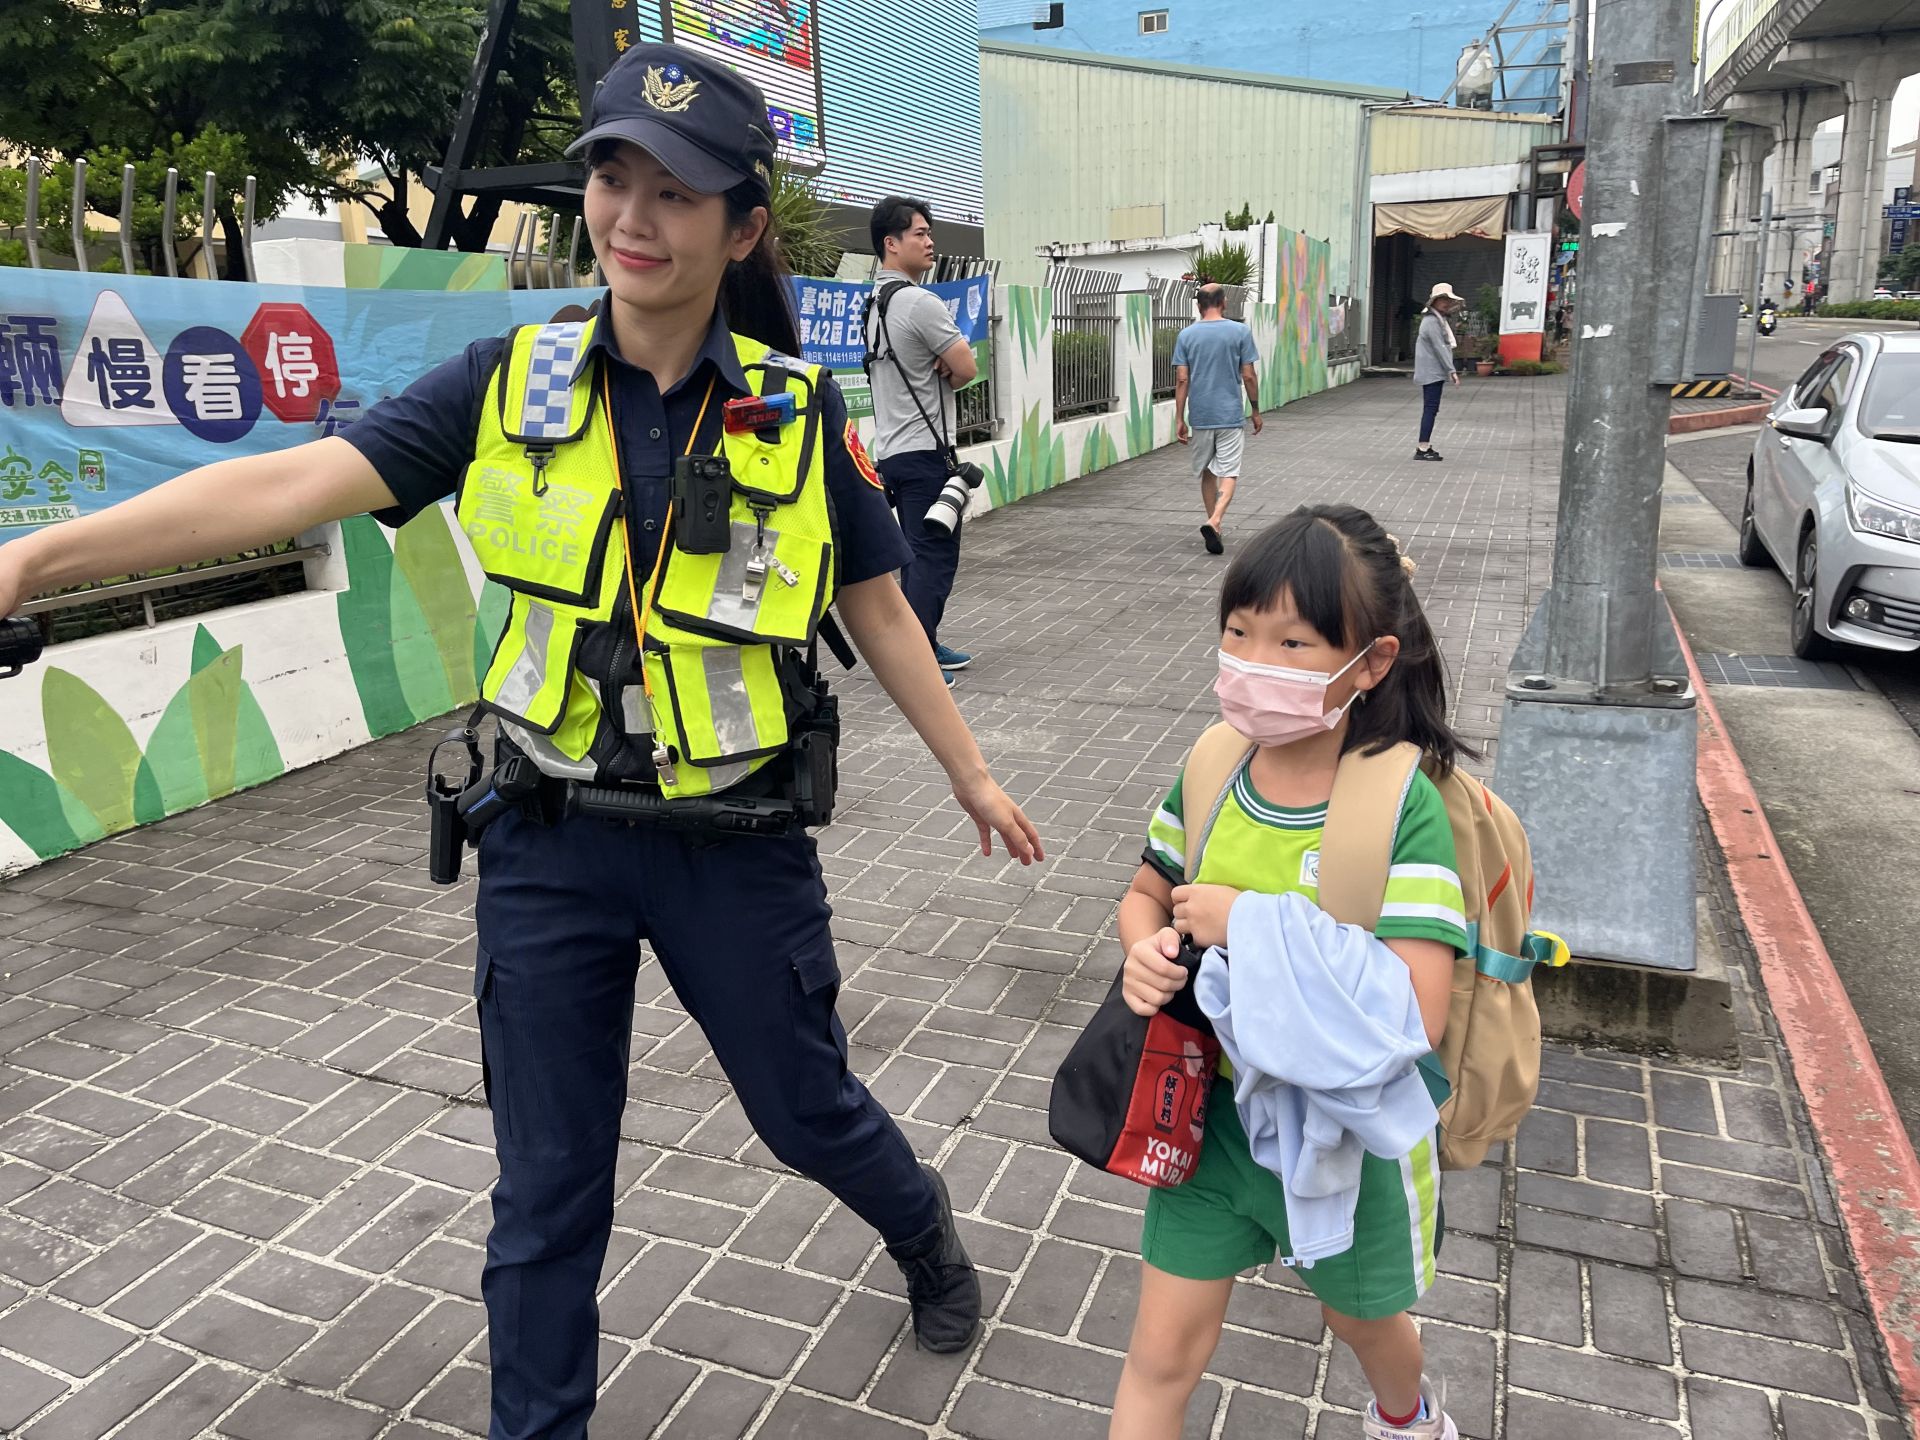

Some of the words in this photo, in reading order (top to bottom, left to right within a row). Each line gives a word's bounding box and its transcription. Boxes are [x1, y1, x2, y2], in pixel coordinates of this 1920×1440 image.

[800, 286, 848, 318] 臺中市
[800, 317, 844, 346] 第42屆
[474, 465, 595, 540] 警察
[466, 521, 580, 567] POLICE
[1140, 1154, 1186, 1186] MURA
[1146, 1136, 1193, 1171] YOKAI
